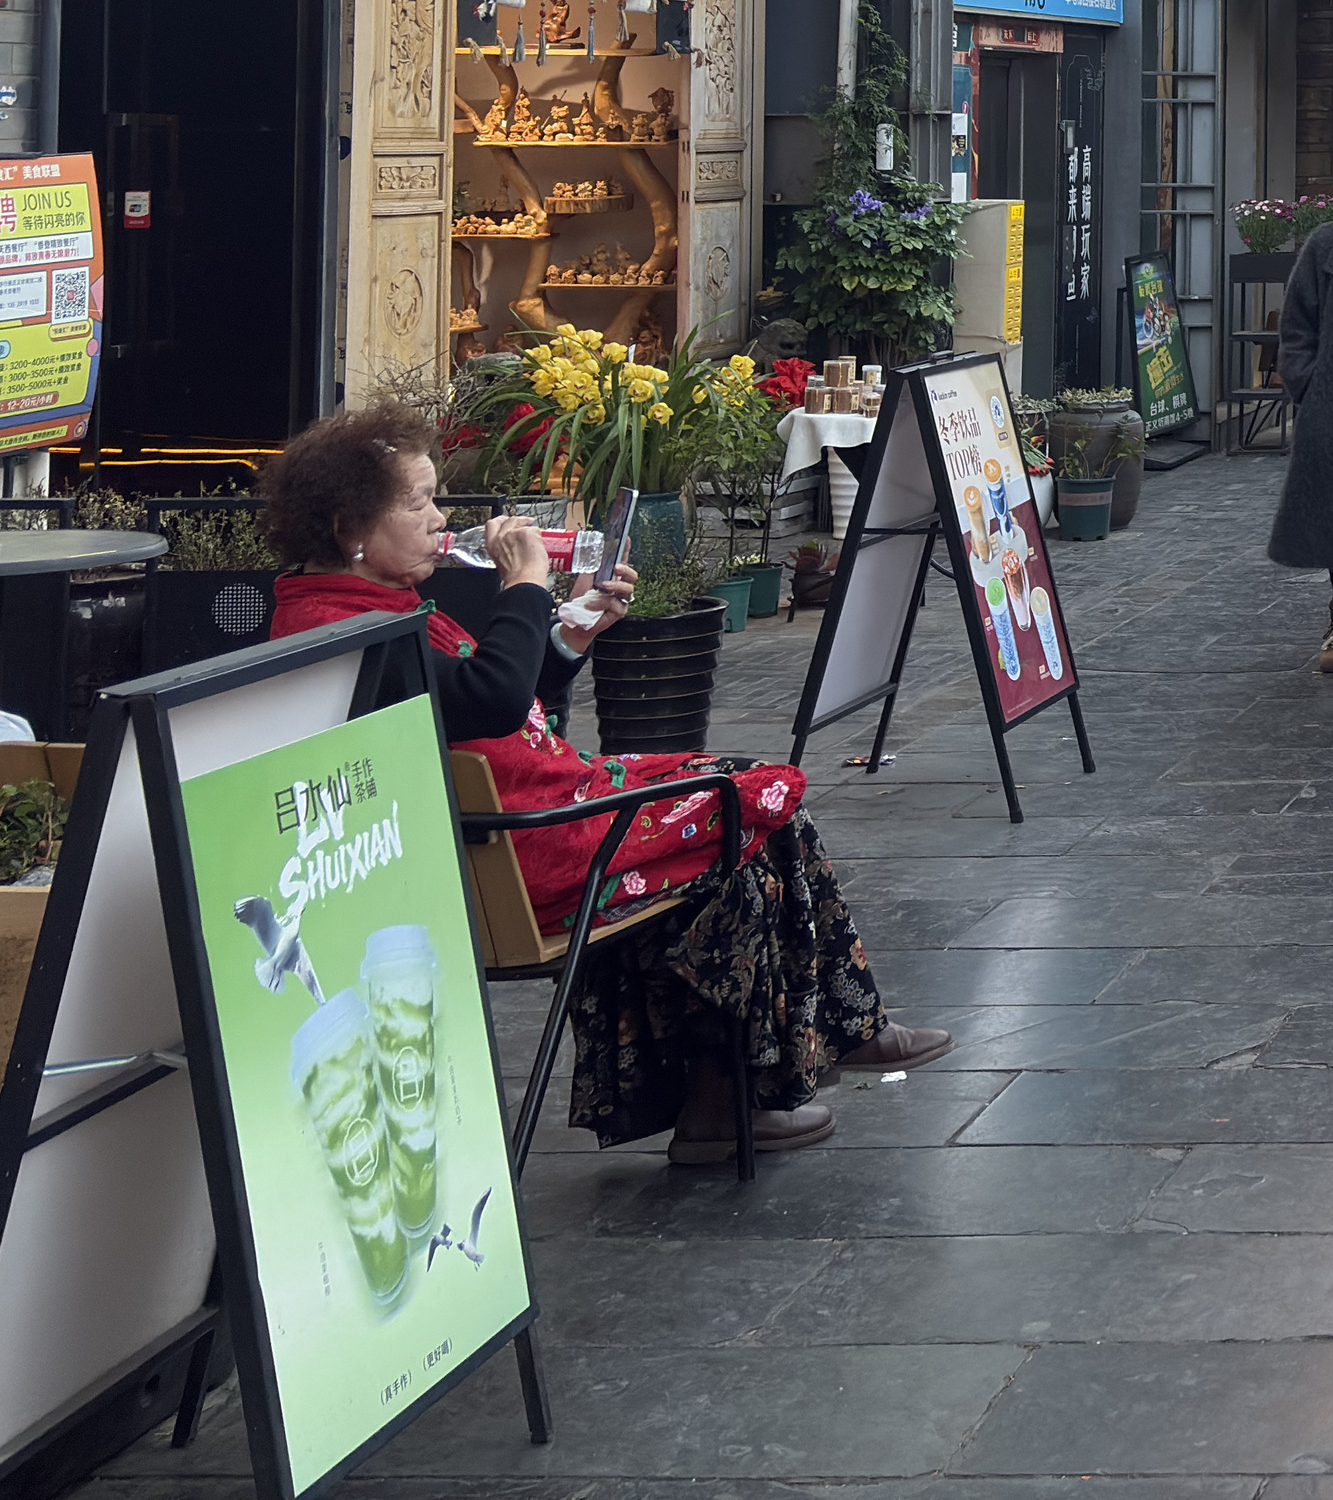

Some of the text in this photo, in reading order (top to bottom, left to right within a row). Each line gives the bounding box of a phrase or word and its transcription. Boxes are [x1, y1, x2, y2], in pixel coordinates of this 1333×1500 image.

[23, 164, 61, 180] 美食联盟
[22, 191, 72, 212] JOIN US
[23, 211, 86, 231] 等待闪亮的你
[938, 407, 982, 445] 冬季饮品
[946, 443, 983, 481] TOP榜
[351, 756, 374, 783] 手作
[274, 767, 352, 835] 吕水仙
[354, 776, 378, 804] 茶铺
[279, 799, 404, 916] SHUIXIAN
